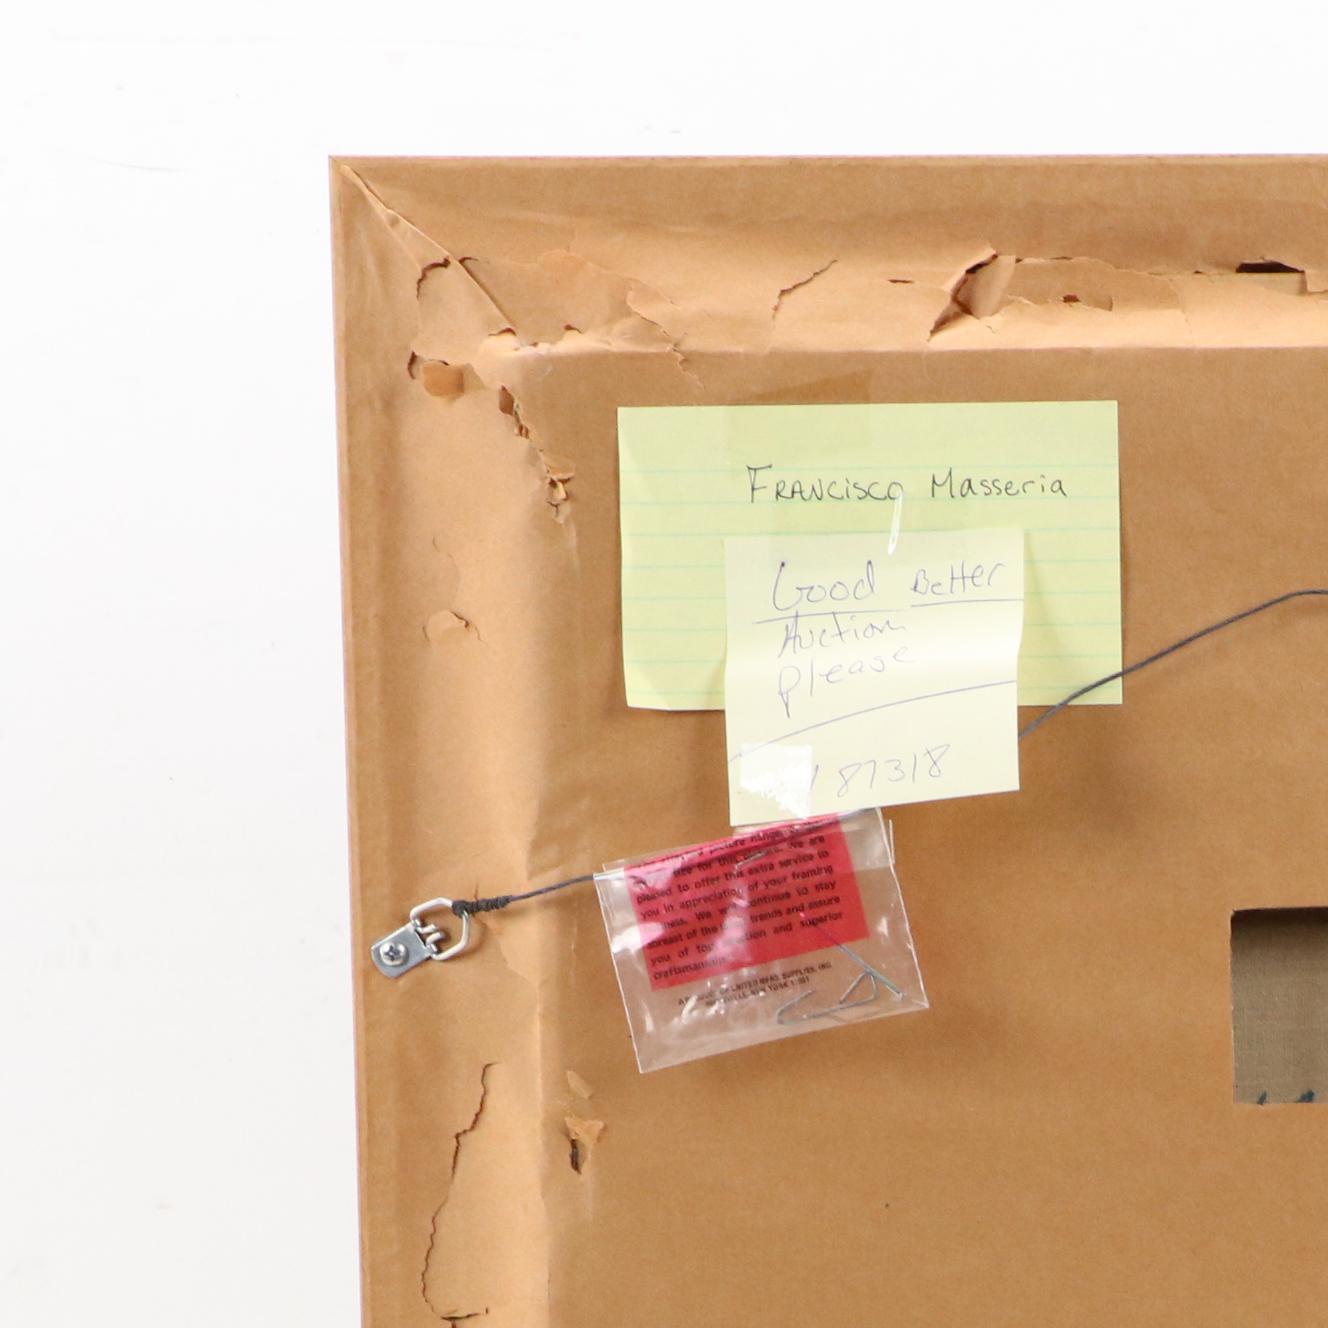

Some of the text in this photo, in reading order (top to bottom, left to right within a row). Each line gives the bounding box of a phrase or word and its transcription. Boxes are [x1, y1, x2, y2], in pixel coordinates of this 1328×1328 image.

[930, 469, 1068, 499] Masseria
[772, 561, 878, 611] Good
[778, 611, 907, 658] Auction
[810, 835, 824, 845] are
[641, 909, 659, 920] you
[664, 904, 674, 913] in
[748, 882, 758, 892] of
[764, 876, 787, 889] your
[792, 865, 833, 880] framing
[678, 883, 690, 893] to
[695, 876, 720, 889] offer
[748, 862, 774, 875] extra
[779, 853, 814, 867] service
[818, 849, 829, 858] to
[687, 930, 697, 939] of
[701, 926, 718, 937] the
[751, 909, 782, 922] trends
[786, 904, 804, 915] and
[808, 896, 840, 908] assure
[696, 911, 712, 920] We
[796, 886, 808, 896] to
[816, 881, 836, 891] stay
[651, 954, 671, 966] you
[678, 948, 689, 958] of
[774, 923, 792, 934] and
[800, 912, 842, 928] superior
